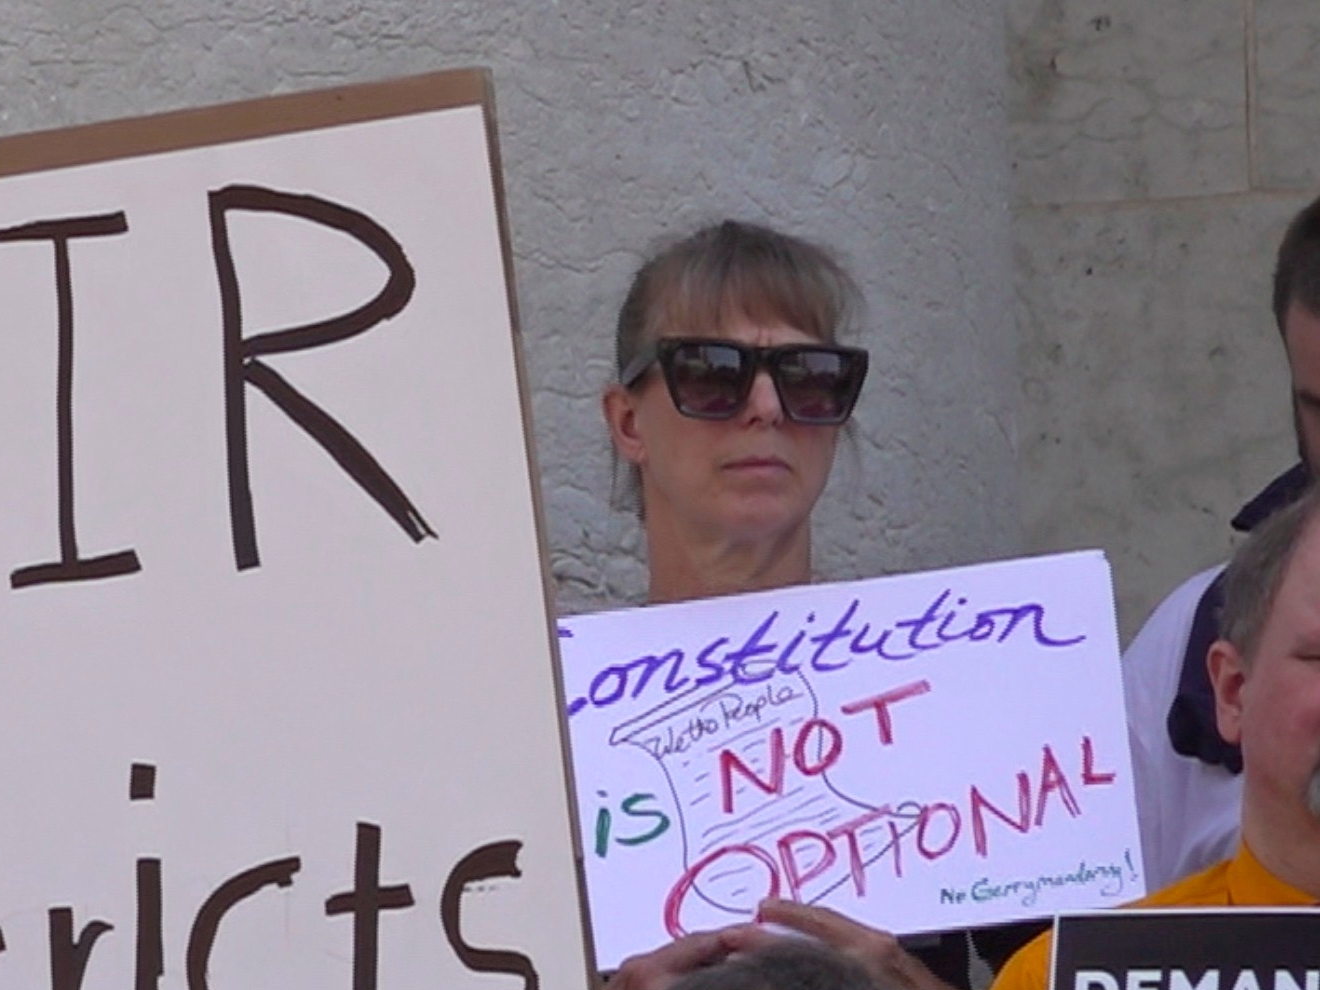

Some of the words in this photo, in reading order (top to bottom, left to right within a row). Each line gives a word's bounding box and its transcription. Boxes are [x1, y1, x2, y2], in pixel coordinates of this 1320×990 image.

[558, 588, 1086, 716] onstitution
[720, 679, 931, 814] NOT
[595, 790, 670, 858] is
[665, 736, 1116, 940] OPTIONAL
